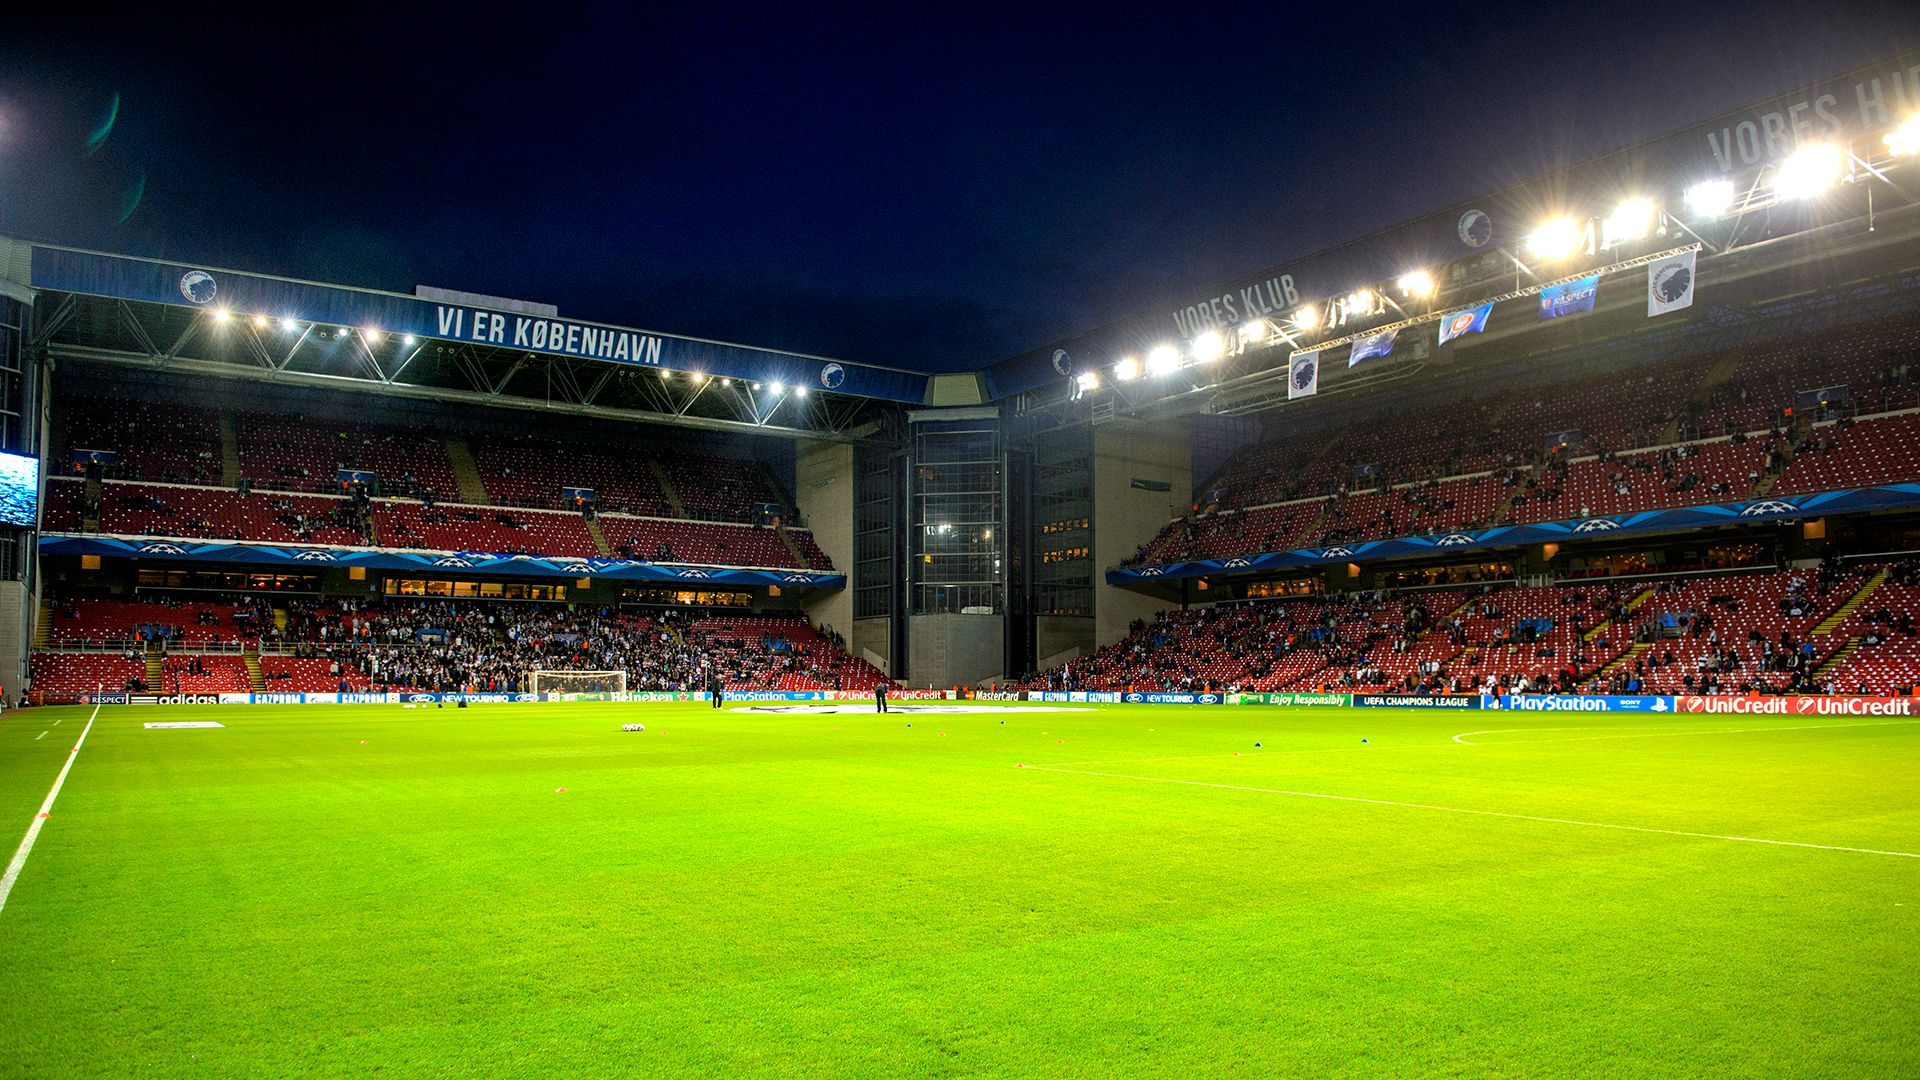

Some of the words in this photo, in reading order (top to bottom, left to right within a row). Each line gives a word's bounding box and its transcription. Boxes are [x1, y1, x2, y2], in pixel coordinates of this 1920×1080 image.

[1707, 93, 1842, 173] VORES
[1173, 293, 1239, 338] VORES
[1240, 274, 1299, 318] KLUB
[438, 306, 463, 338] VI
[472, 311, 506, 343] ER
[514, 317, 662, 365] KØBENHAVN
[159, 694, 217, 704] adidas
[254, 694, 301, 704] GAZPROM
[342, 693, 385, 703] GAZPROM
[441, 695, 461, 703] NEW
[463, 695, 508, 703] TOURNEO
[611, 691, 673, 702] Heineken
[901, 691, 941, 700] UniCredit
[975, 690, 1019, 701] MasterCard
[1044, 692, 1067, 702] GAZPROM
[1088, 693, 1113, 703] GAZPROM
[1161, 695, 1194, 703] TOURNEO
[1269, 694, 1293, 706] Enjoy
[1294, 694, 1345, 707] Responsibly
[1363, 697, 1385, 705] UEFA
[1385, 697, 1434, 706] CHAMPIONS
[1435, 698, 1469, 706] LEAGUE
[1705, 697, 1788, 714] UniCredit
[1816, 697, 1911, 716] UniCredit
